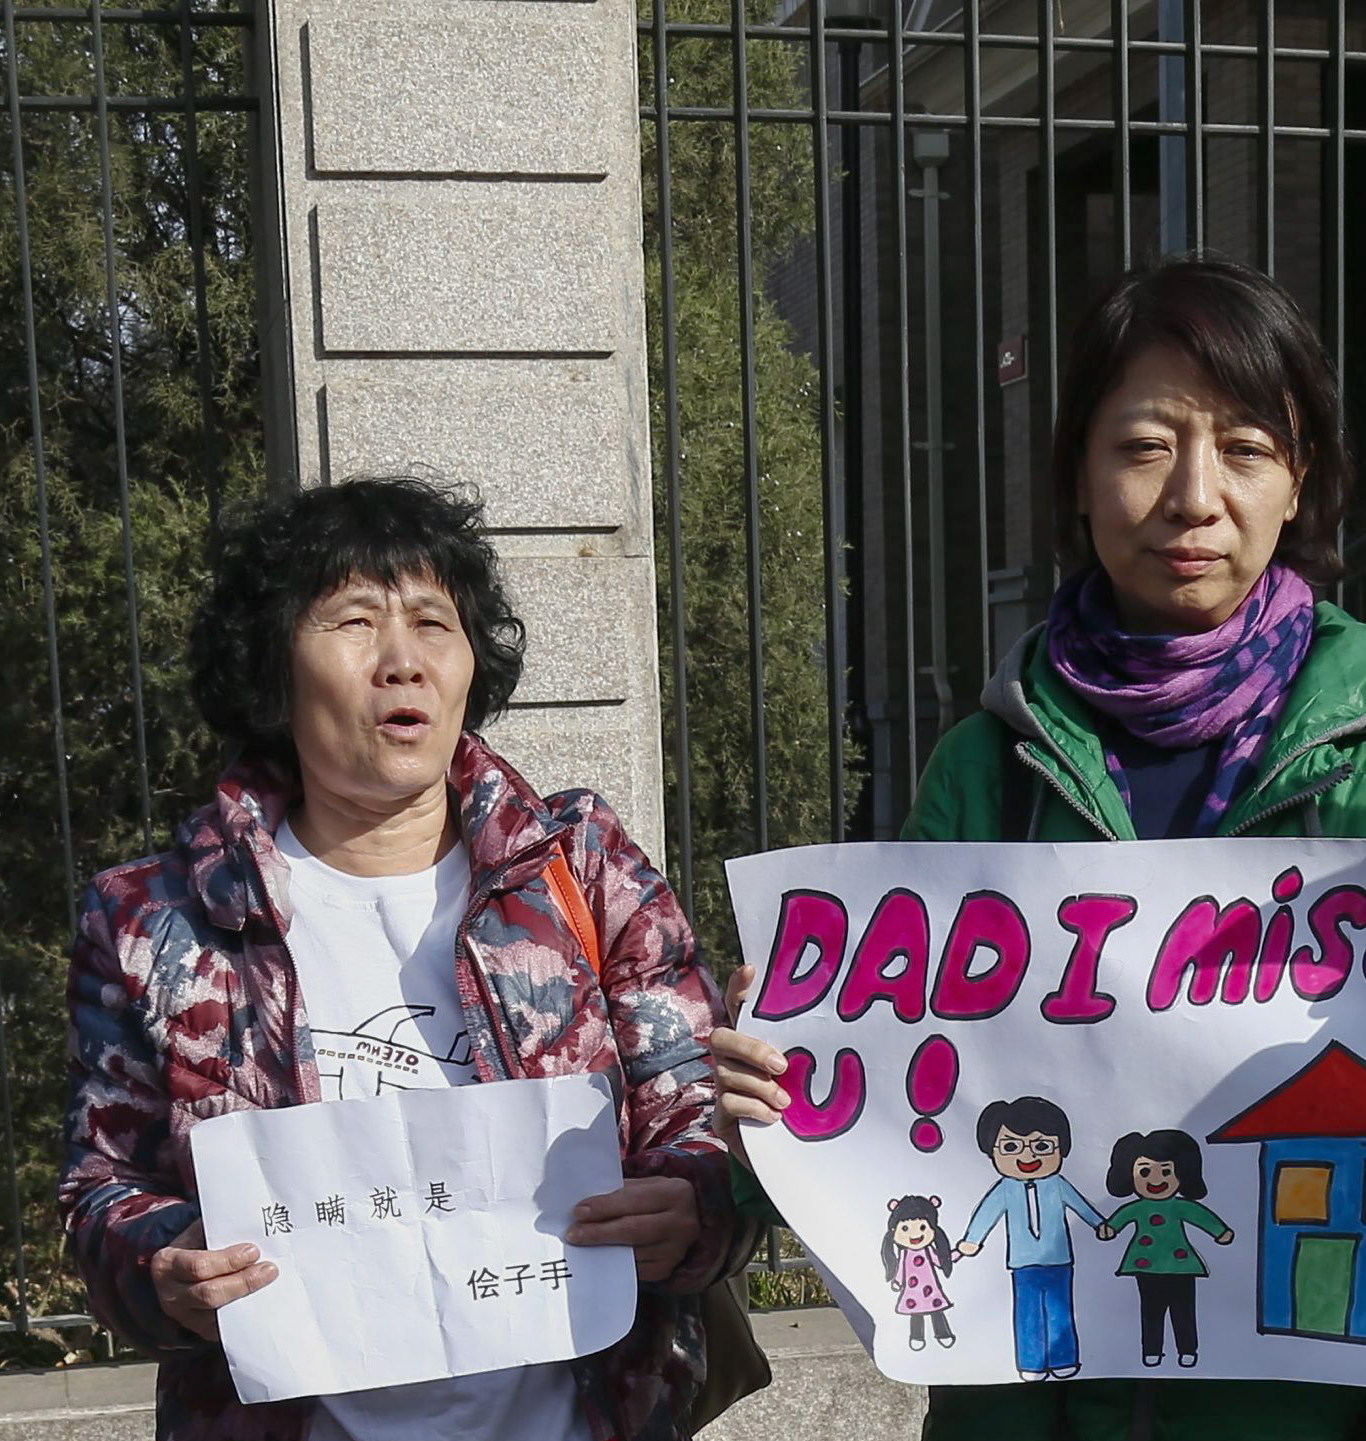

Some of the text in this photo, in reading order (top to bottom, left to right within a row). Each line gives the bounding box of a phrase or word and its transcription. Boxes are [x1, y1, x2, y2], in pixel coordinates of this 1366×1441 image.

[752, 886, 1032, 1022] DAD
[1041, 893, 1137, 1024] I
[355, 1040, 420, 1066] MH370
